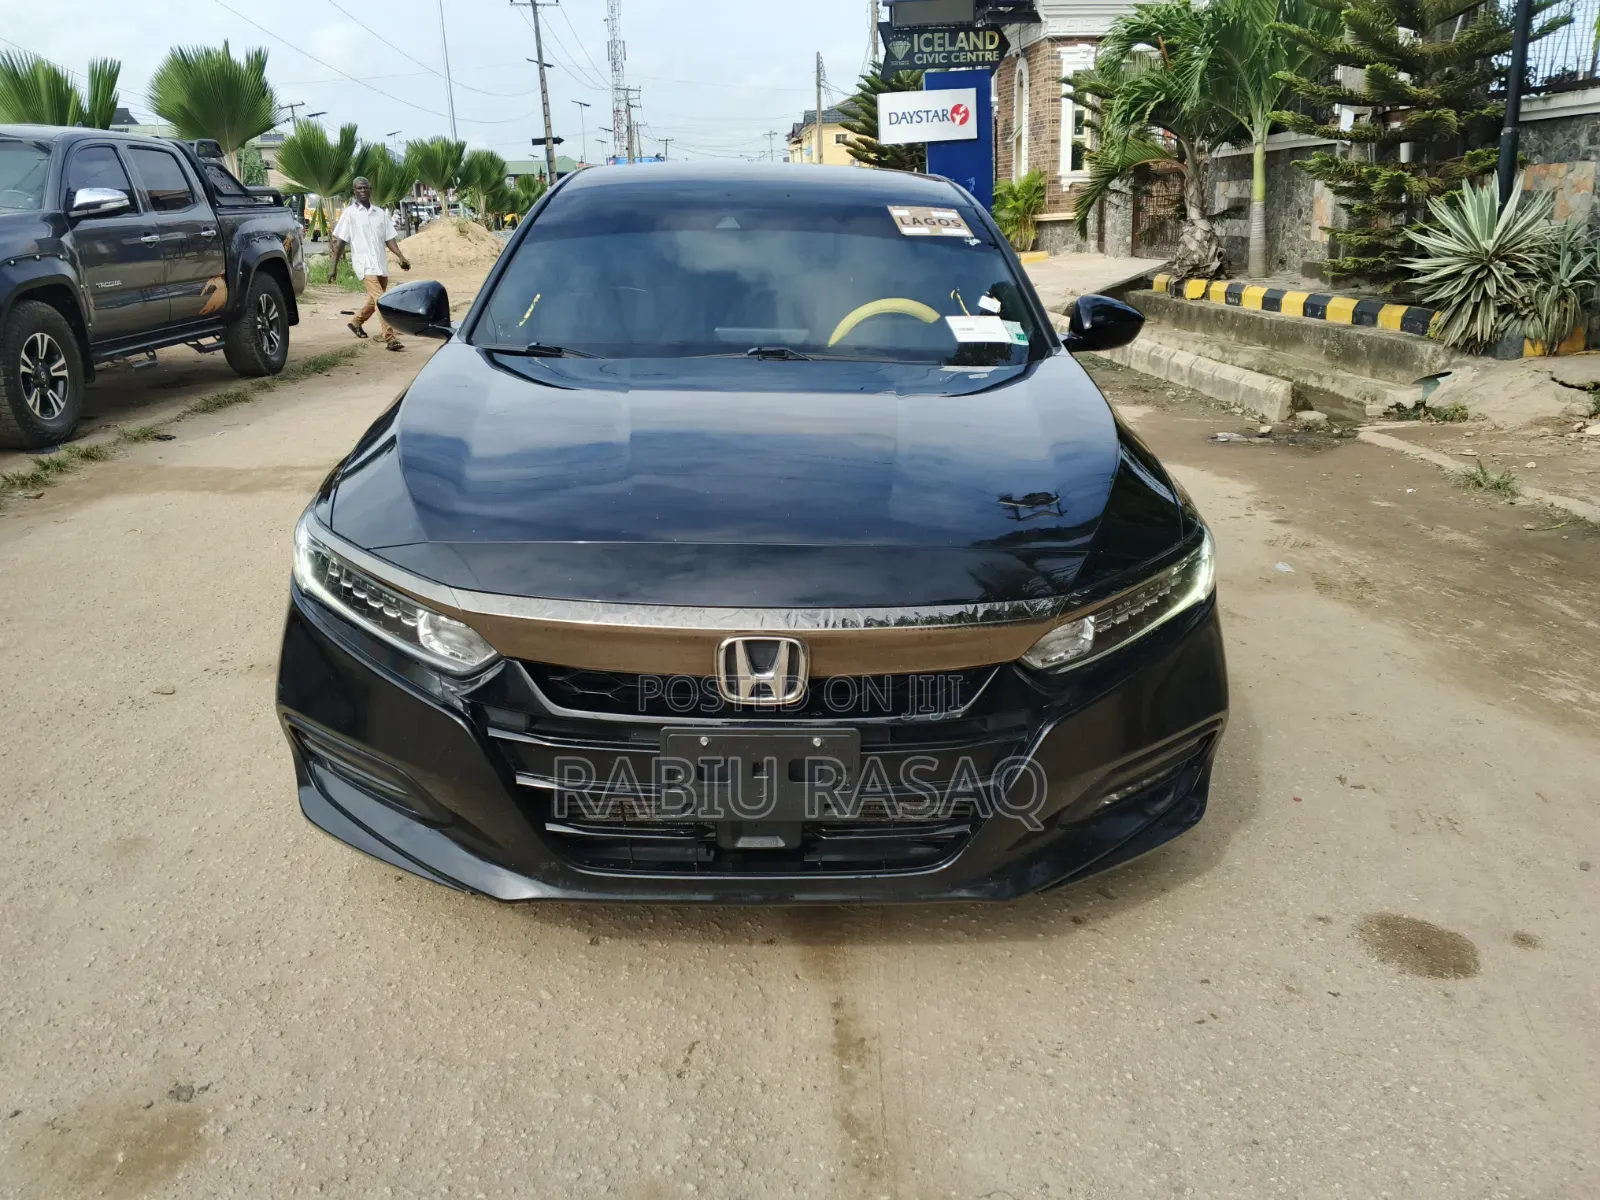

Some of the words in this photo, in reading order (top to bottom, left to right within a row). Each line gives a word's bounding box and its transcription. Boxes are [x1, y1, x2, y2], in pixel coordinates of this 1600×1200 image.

[913, 31, 999, 52] ICELAND
[914, 52, 948, 65] CIVIC
[951, 51, 1000, 63] CENTRE
[888, 109, 951, 126] DAYSTAR
[899, 216, 962, 227] LAGOS
